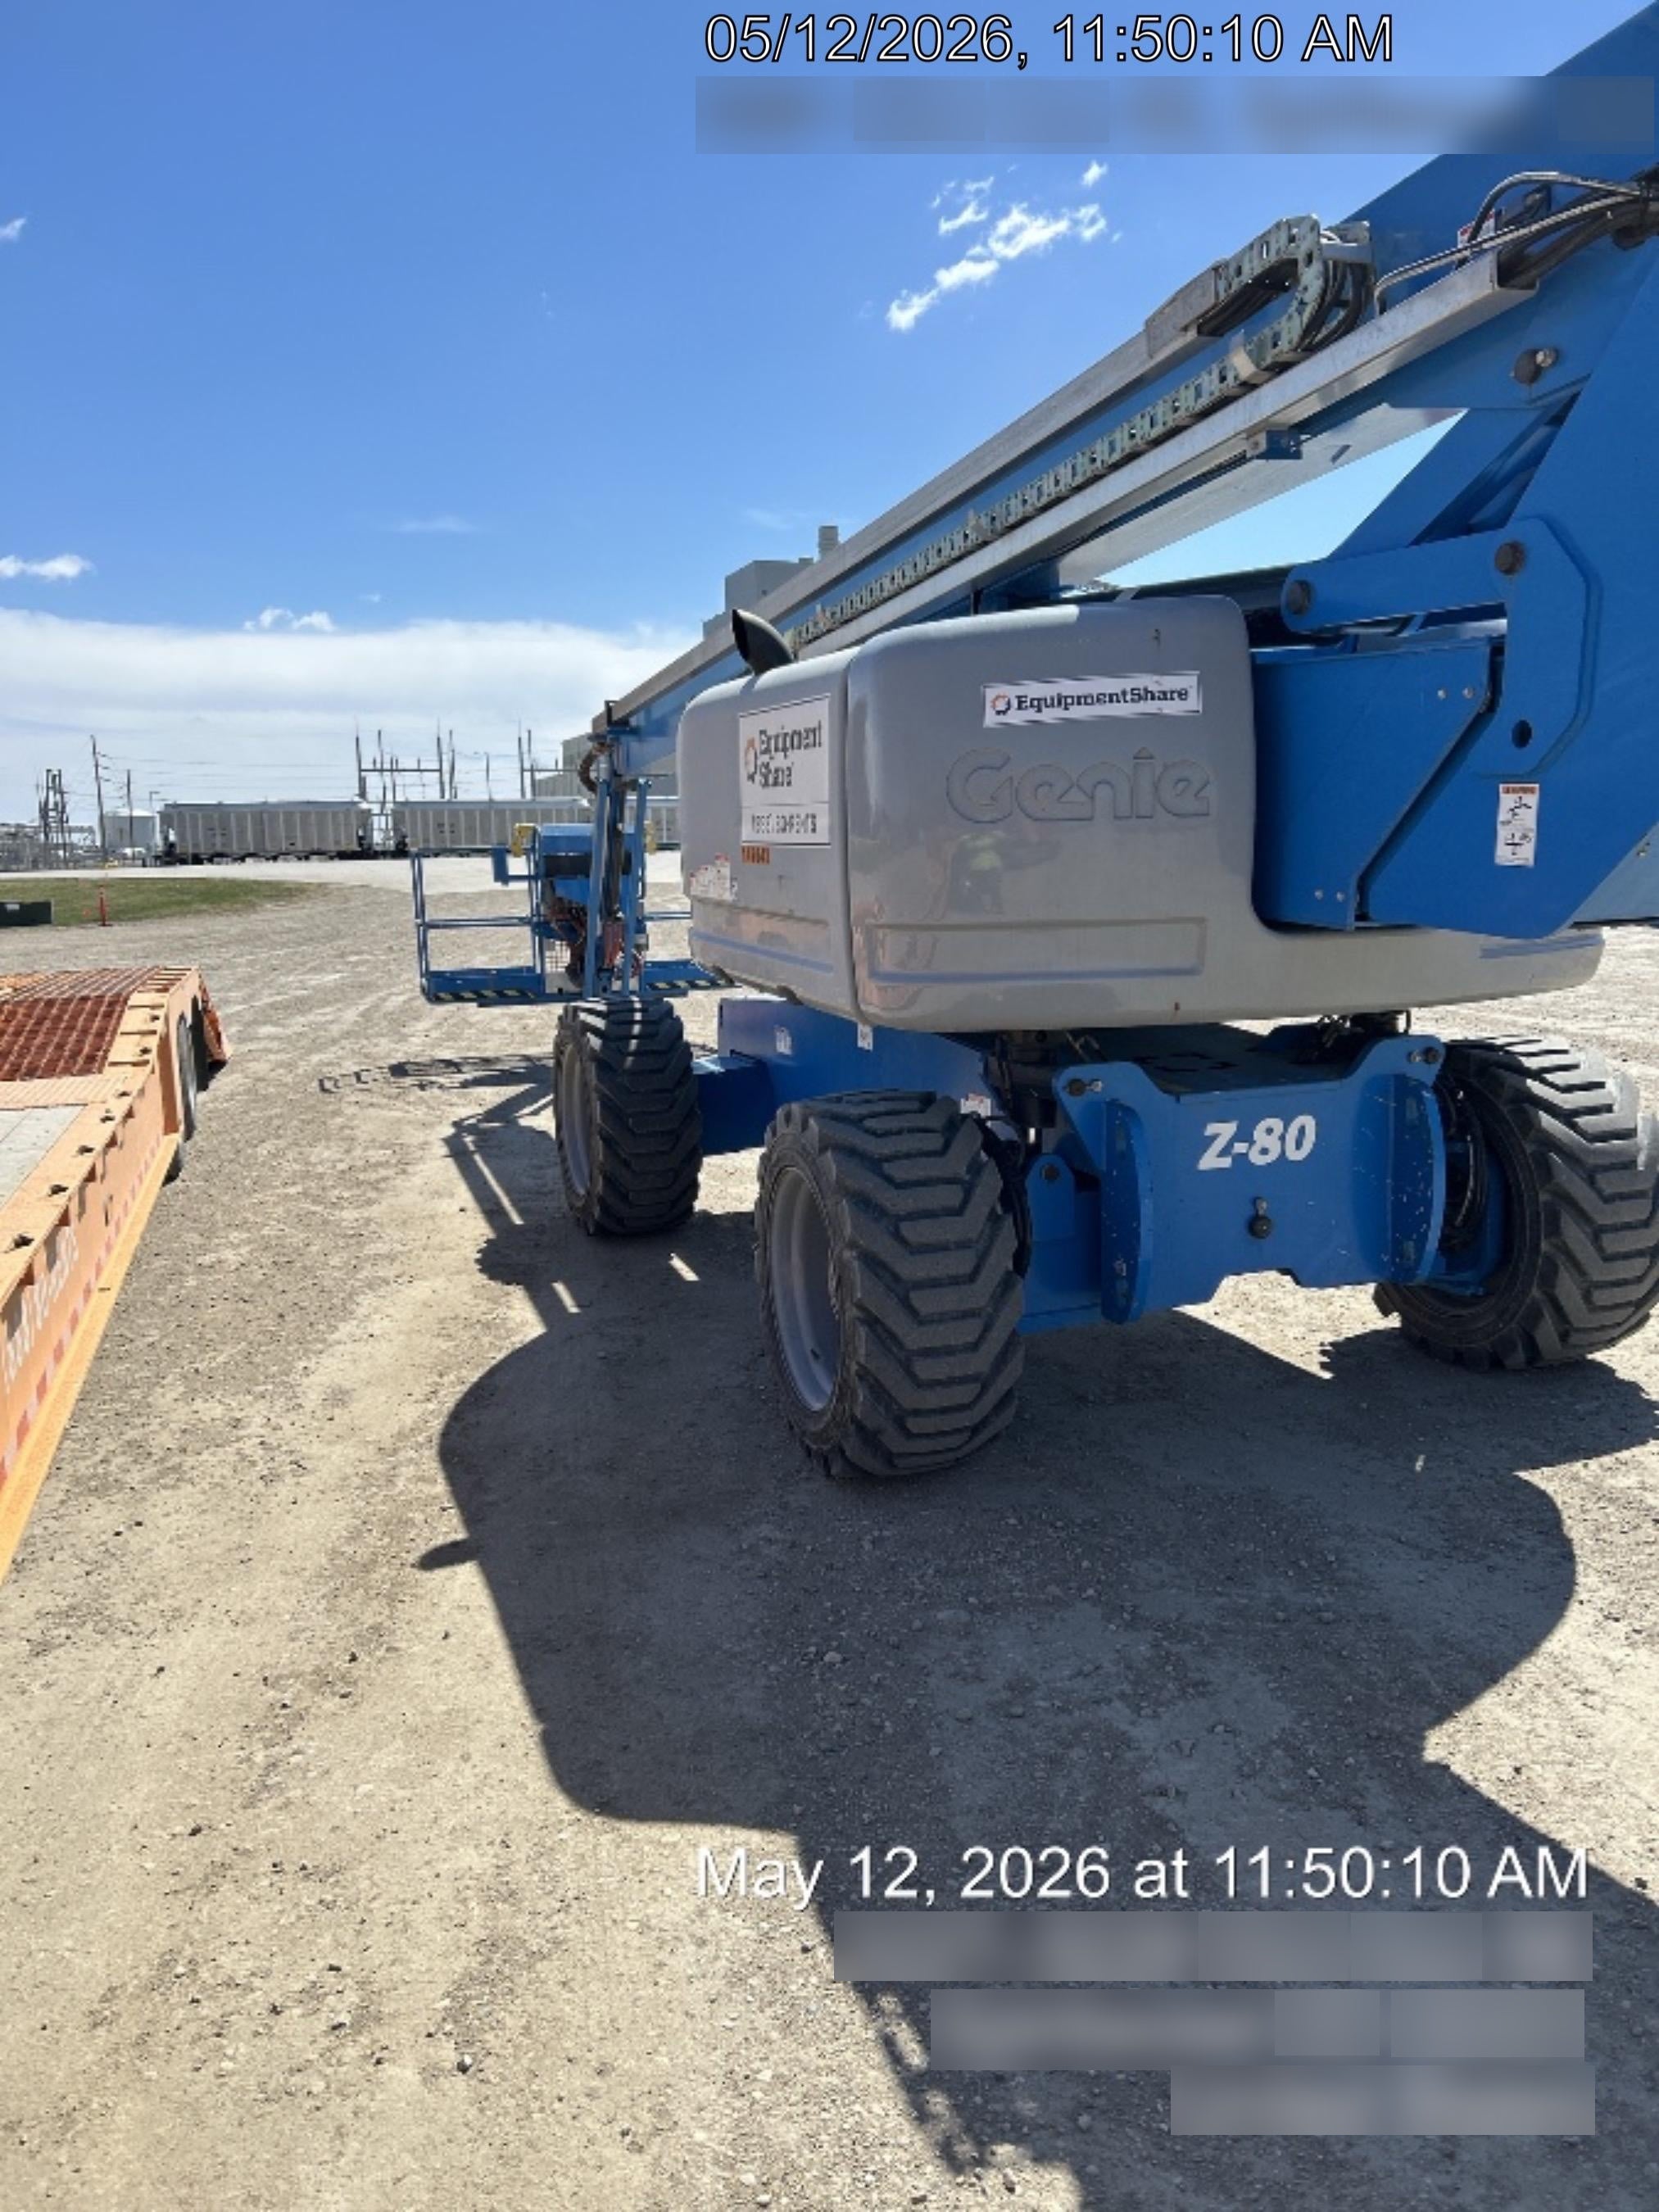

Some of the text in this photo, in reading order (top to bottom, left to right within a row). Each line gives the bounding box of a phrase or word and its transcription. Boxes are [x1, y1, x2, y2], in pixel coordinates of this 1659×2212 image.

[1015, 687, 1188, 713] EquipmentShare
[945, 746, 1210, 823] Genie
[1197, 1115, 1316, 1170] Z-80
